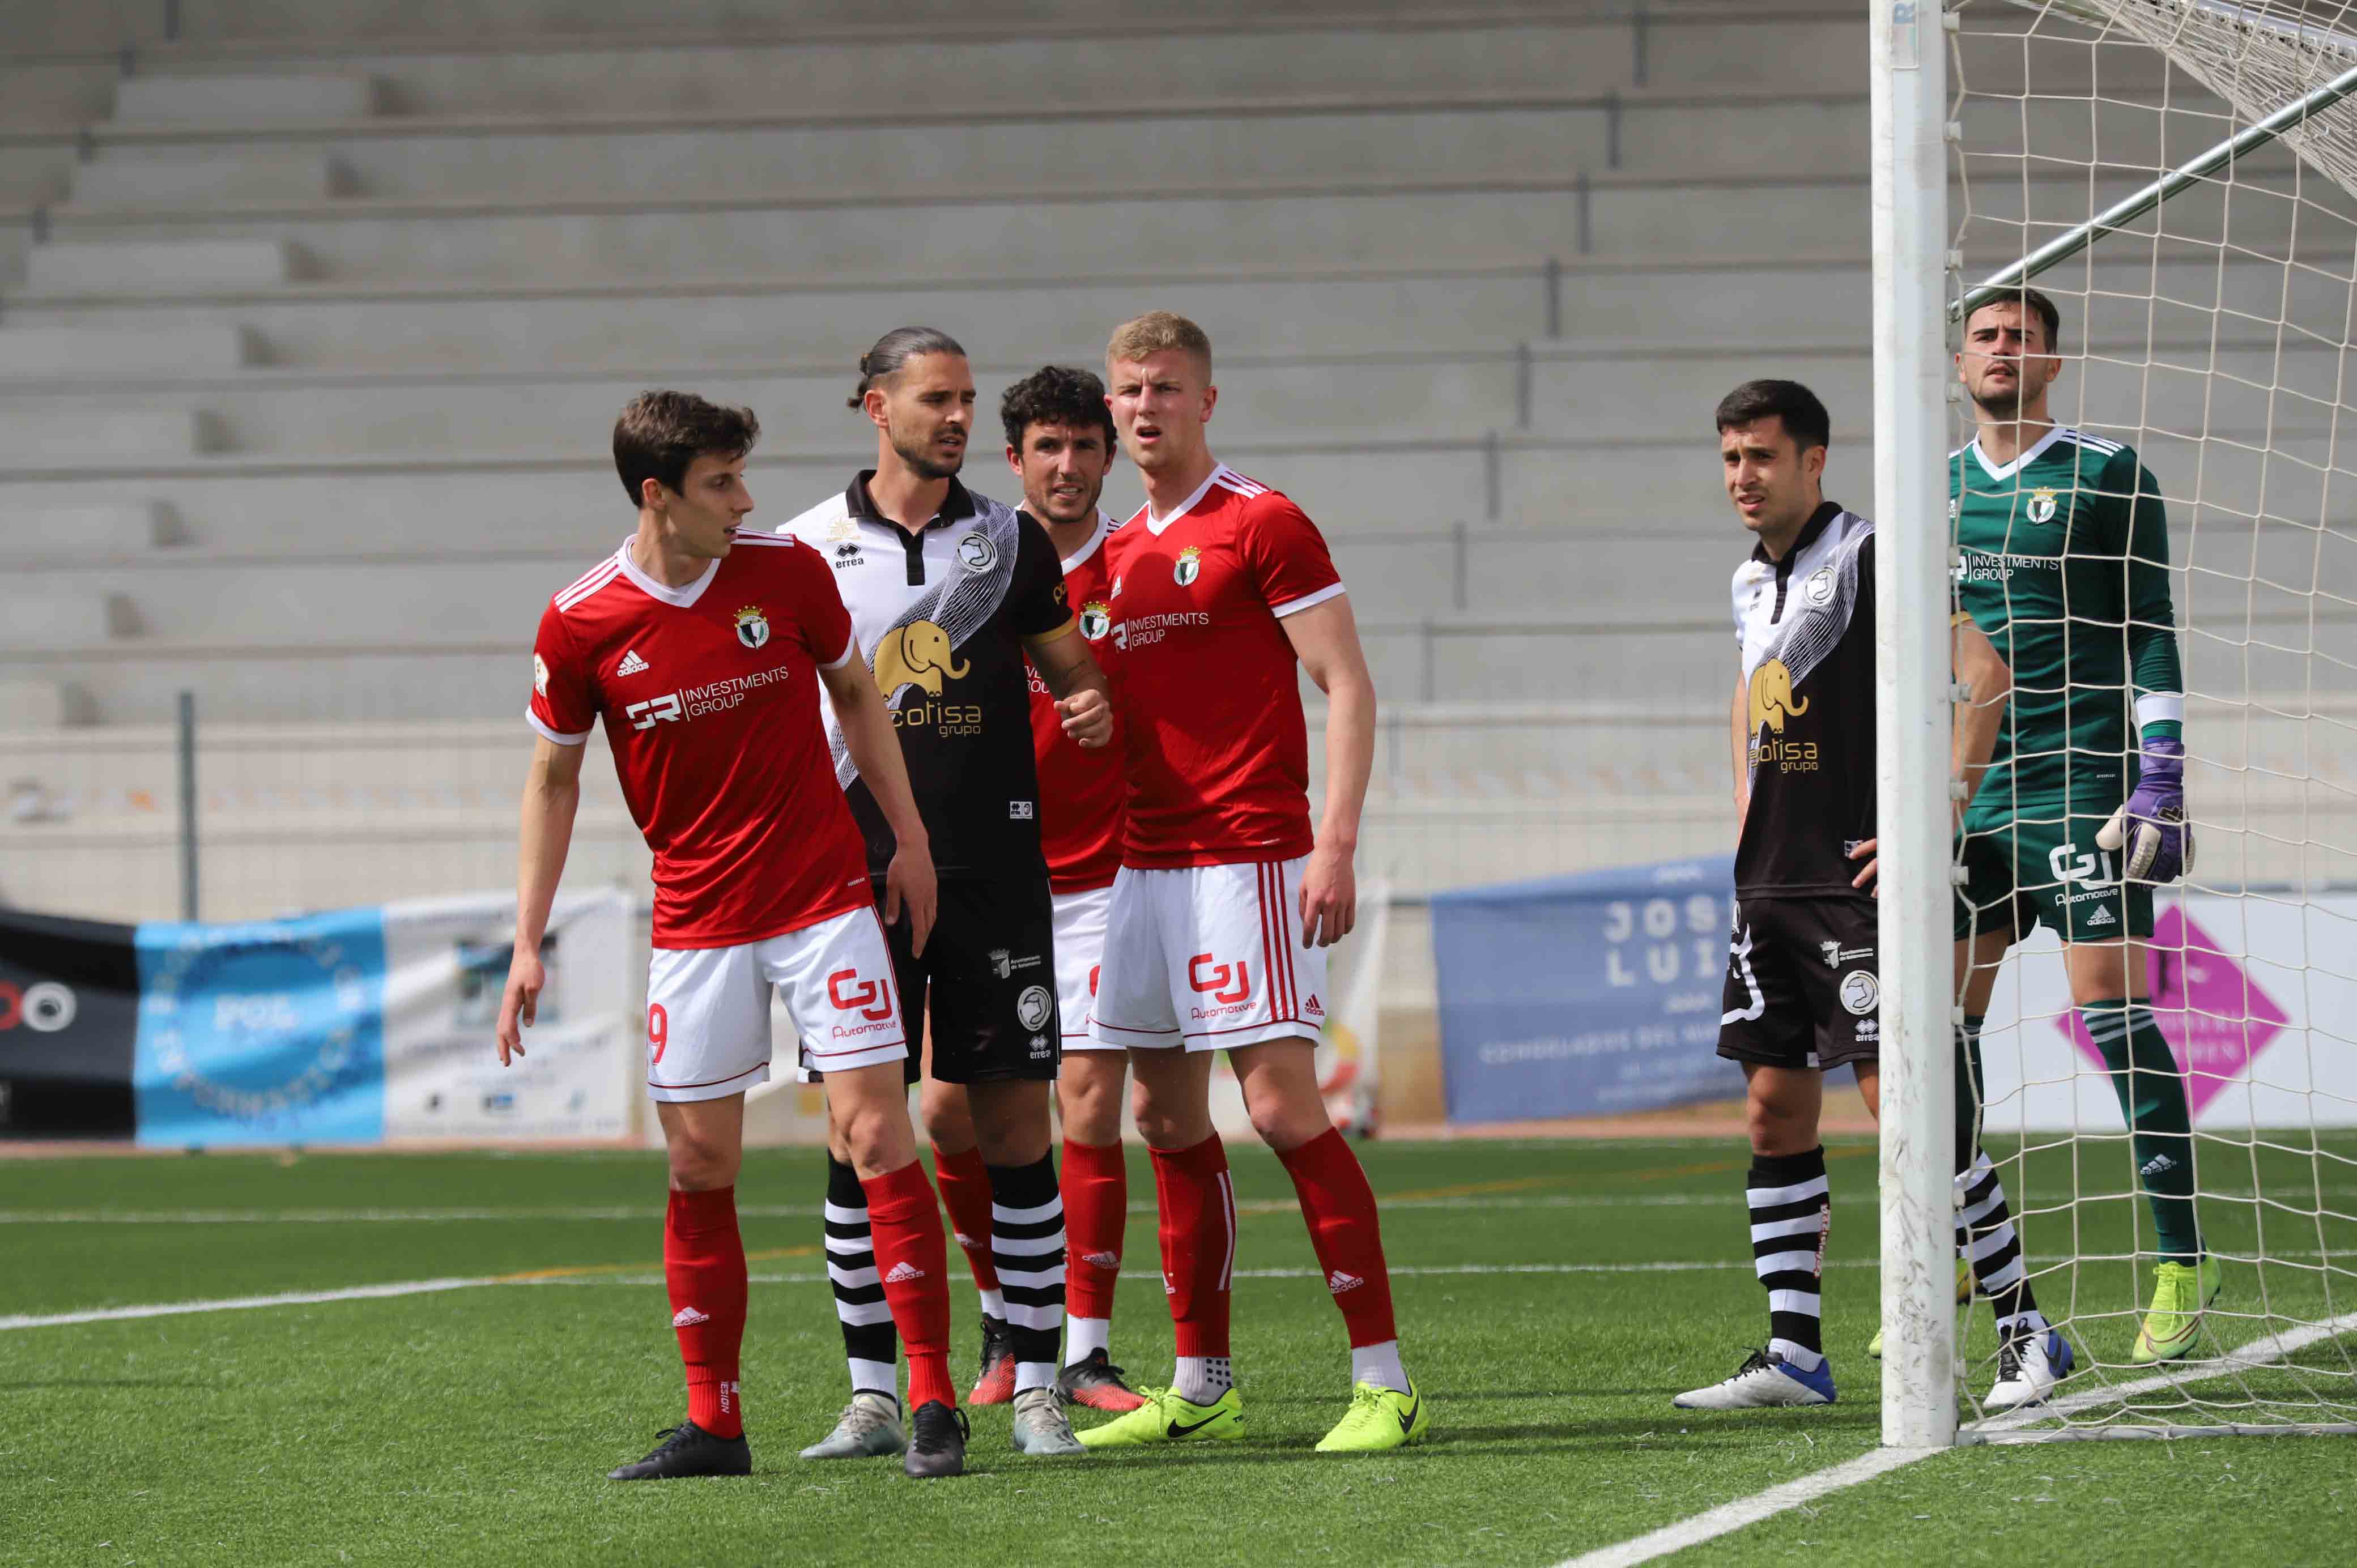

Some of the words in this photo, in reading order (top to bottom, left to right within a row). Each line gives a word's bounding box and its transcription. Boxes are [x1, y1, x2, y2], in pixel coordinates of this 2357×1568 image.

[1972, 555, 2059, 570] INVESTMENTS
[1972, 568, 2014, 581] GROUP
[1130, 612, 1210, 632] INVESTMENTS
[1131, 629, 1165, 647] GROUP
[617, 662, 650, 677] adidas
[685, 666, 789, 702] INVESTMENTS
[689, 693, 744, 717] GROUP
[939, 725, 981, 738] grupo
[1781, 762, 1818, 774] grupo
[2055, 889, 2118, 907] Automotive
[1603, 894, 1717, 943] JOS
[2087, 916, 2116, 926] adidas
[1191, 1002, 1256, 1020] Automotive
[648, 1003, 668, 1066] 9
[833, 1021, 897, 1039] Automotive
[1029, 1049, 1051, 1059] errea
